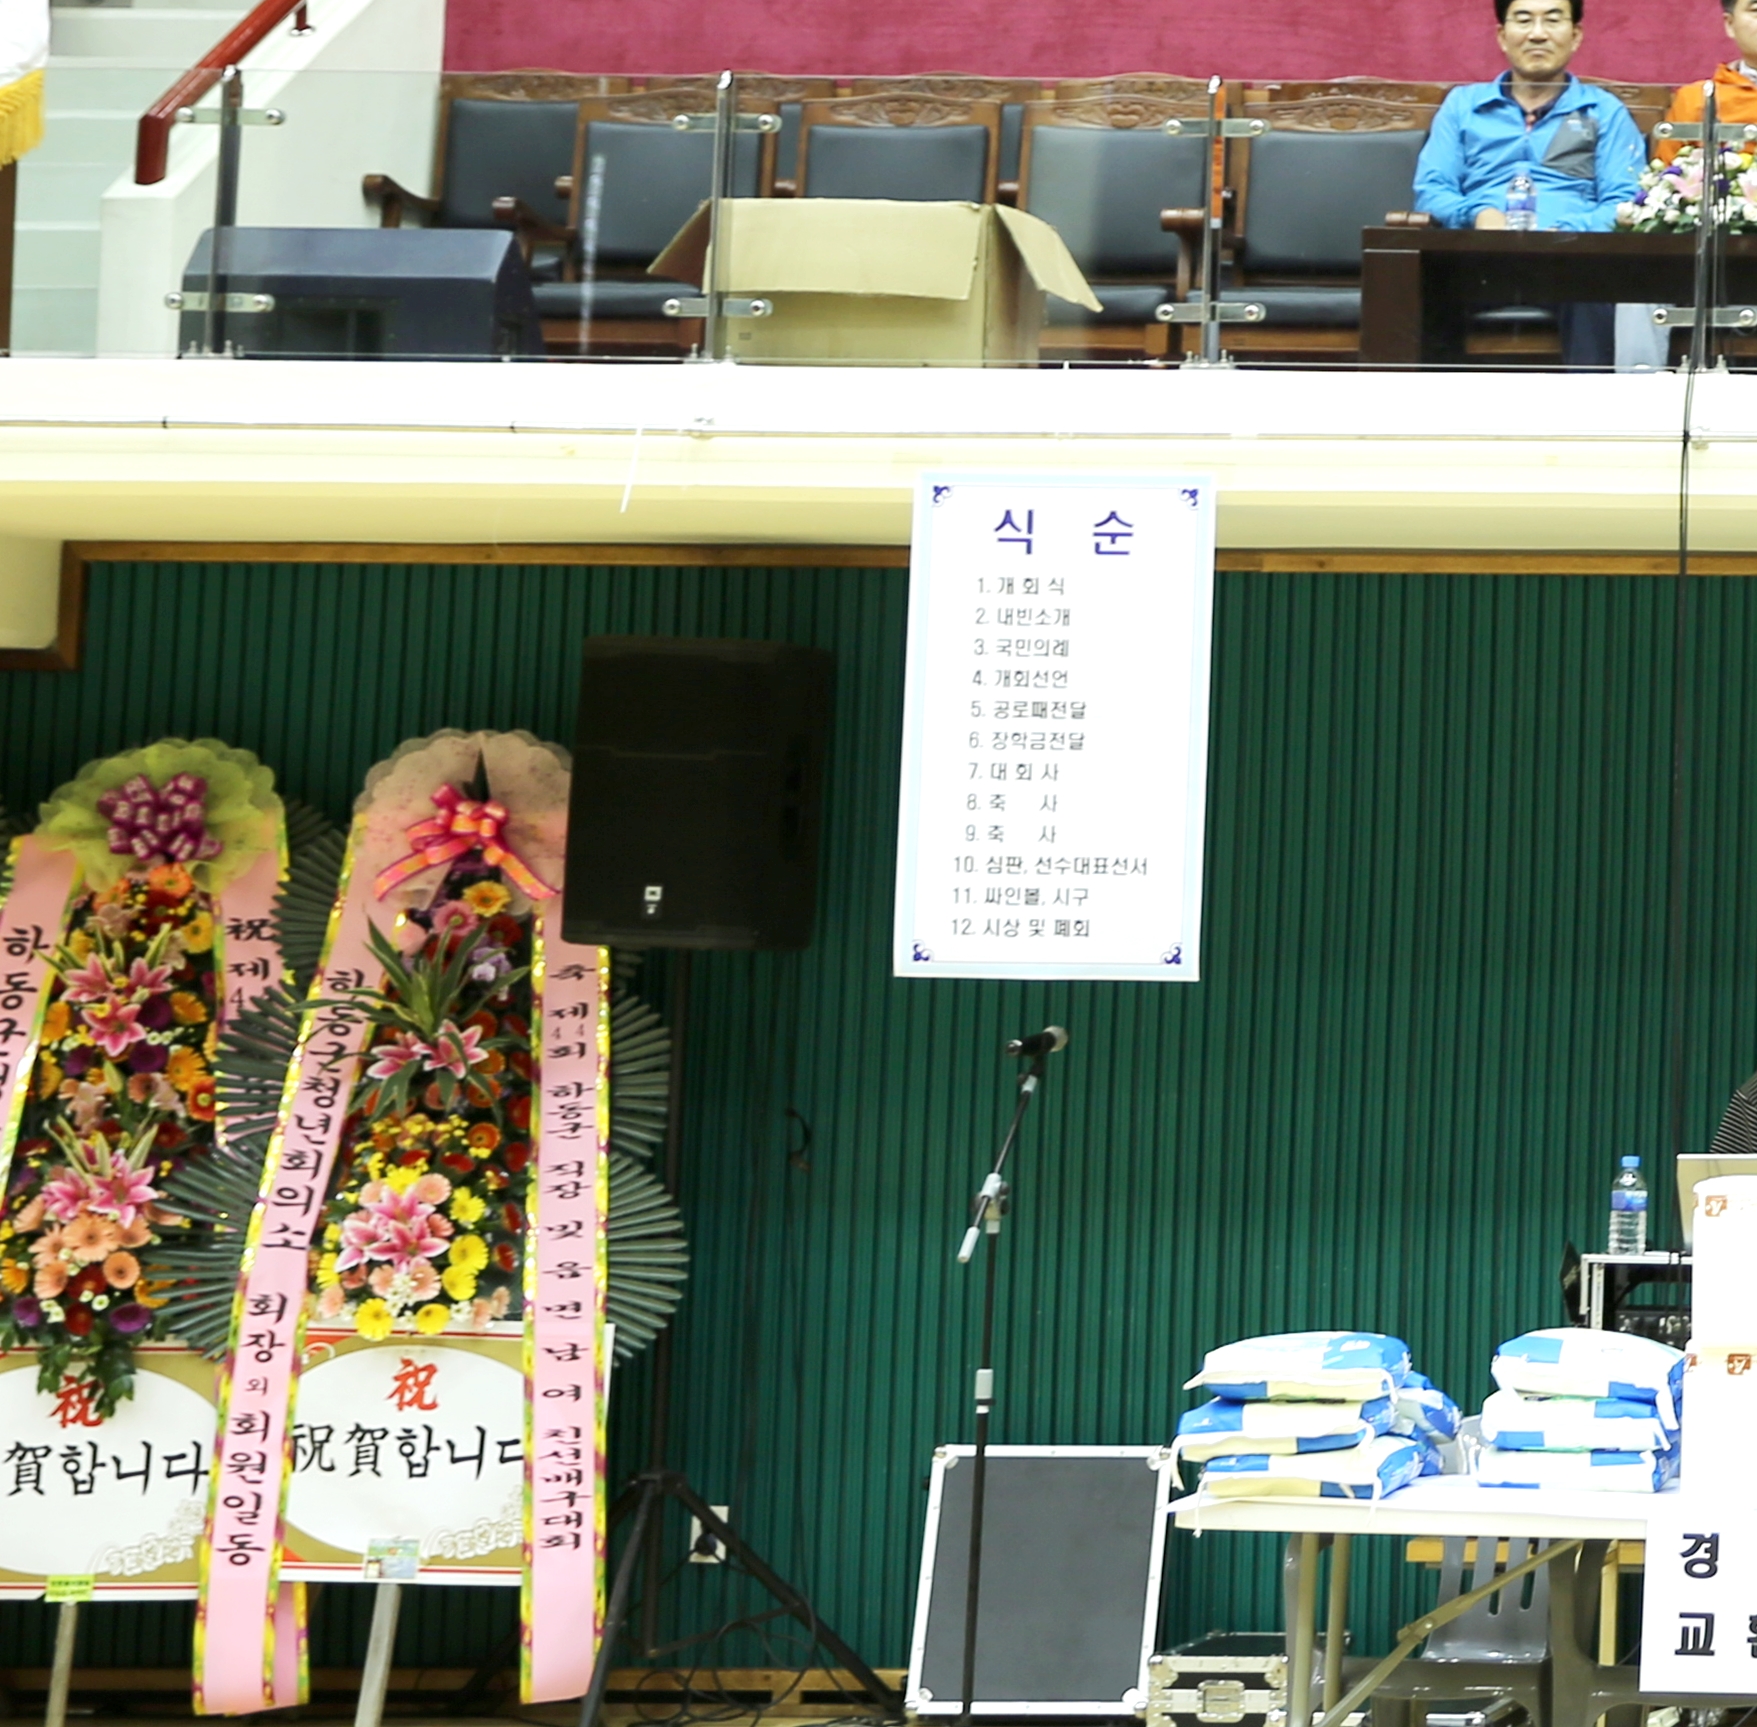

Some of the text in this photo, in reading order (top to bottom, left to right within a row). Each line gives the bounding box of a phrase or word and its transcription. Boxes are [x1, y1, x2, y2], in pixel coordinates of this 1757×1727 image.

[977, 577, 991, 594] 1.
[975, 607, 1071, 627] 2. 내빈소개
[973, 638, 1070, 658] 3. 국민의례
[972, 669, 1069, 689] 4. 개회선언
[970, 700, 1087, 720] 5. 공로패전달
[969, 731, 1086, 751] 6. 장학금전달
[968, 762, 983, 781] 7.
[966, 793, 982, 811] 8.
[965, 824, 981, 842] 9.
[954, 855, 978, 874] 10.
[1035, 856, 1148, 876] 선수대표선서
[953, 886, 978, 905] 11.
[1052, 887, 1090, 907] 시구
[951, 917, 1091, 938] 12. 시상 및 폐회
[546, 1081, 595, 1140] 하동군
[542, 1159, 592, 1200] 직장
[240, 1291, 288, 1364] 회장
[541, 1341, 590, 1362] 남
[245, 1376, 270, 1397] 외
[384, 1355, 441, 1412] 祝
[541, 1383, 583, 1403] 여
[214, 1409, 272, 1568] 회원일동
